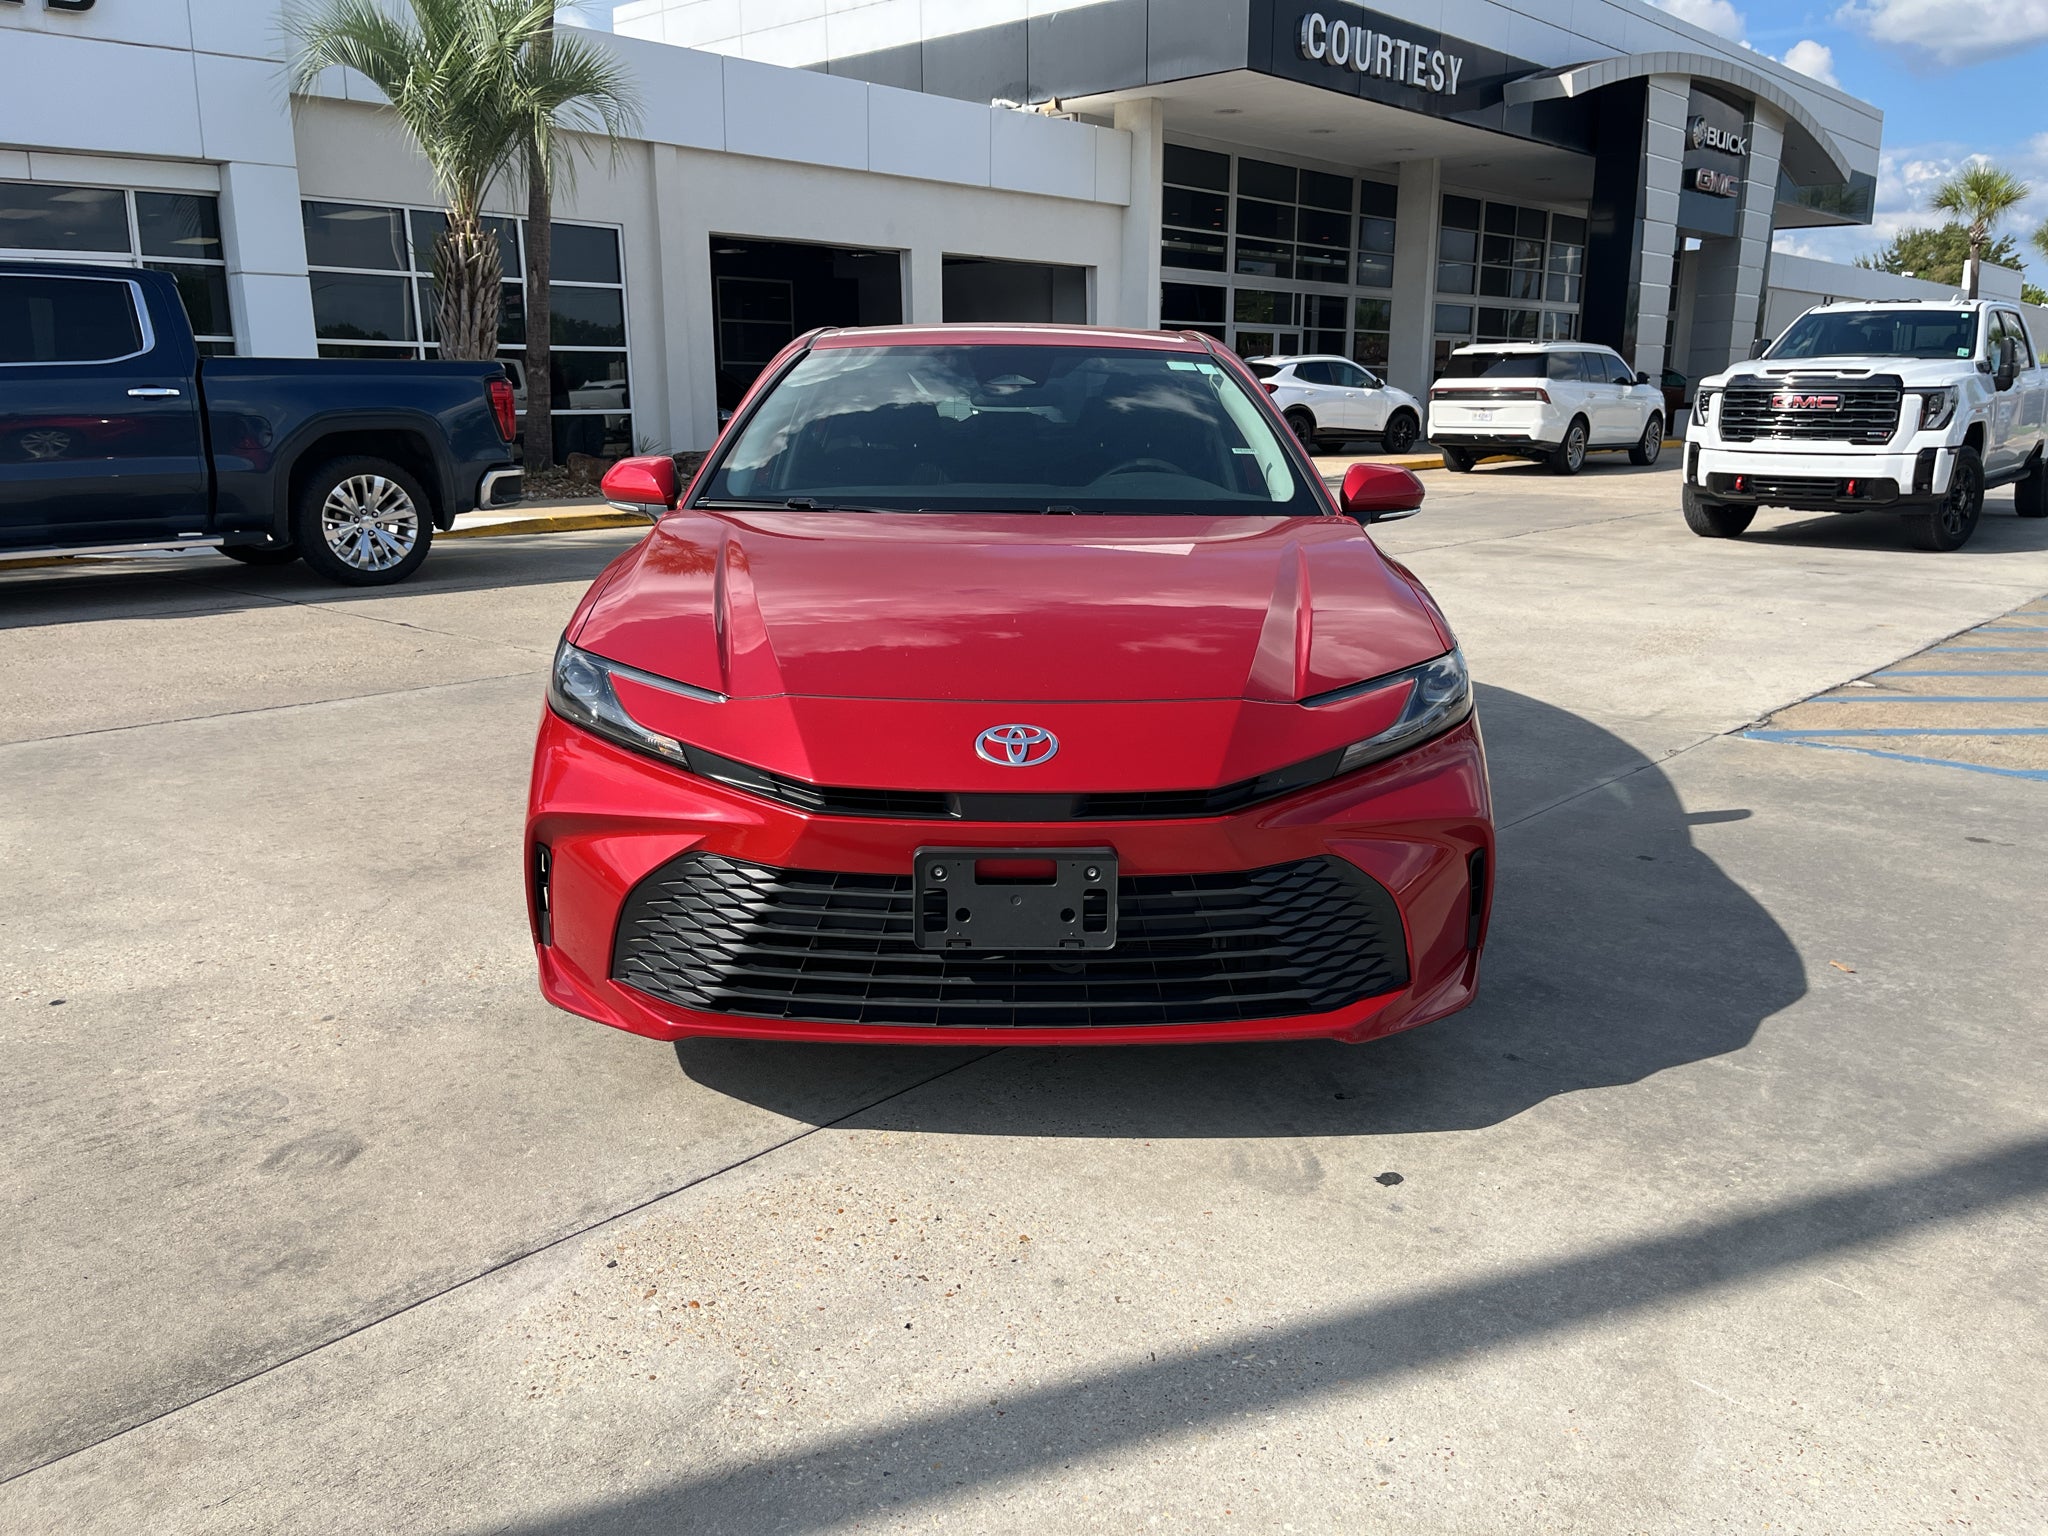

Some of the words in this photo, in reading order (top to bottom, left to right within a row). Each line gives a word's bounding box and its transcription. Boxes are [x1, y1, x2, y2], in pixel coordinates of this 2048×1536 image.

[1301, 12, 1463, 96] COURTESY
[1706, 126, 1748, 155] BUICK
[1696, 167, 1739, 197] GMC
[1771, 395, 1839, 409] GMC
